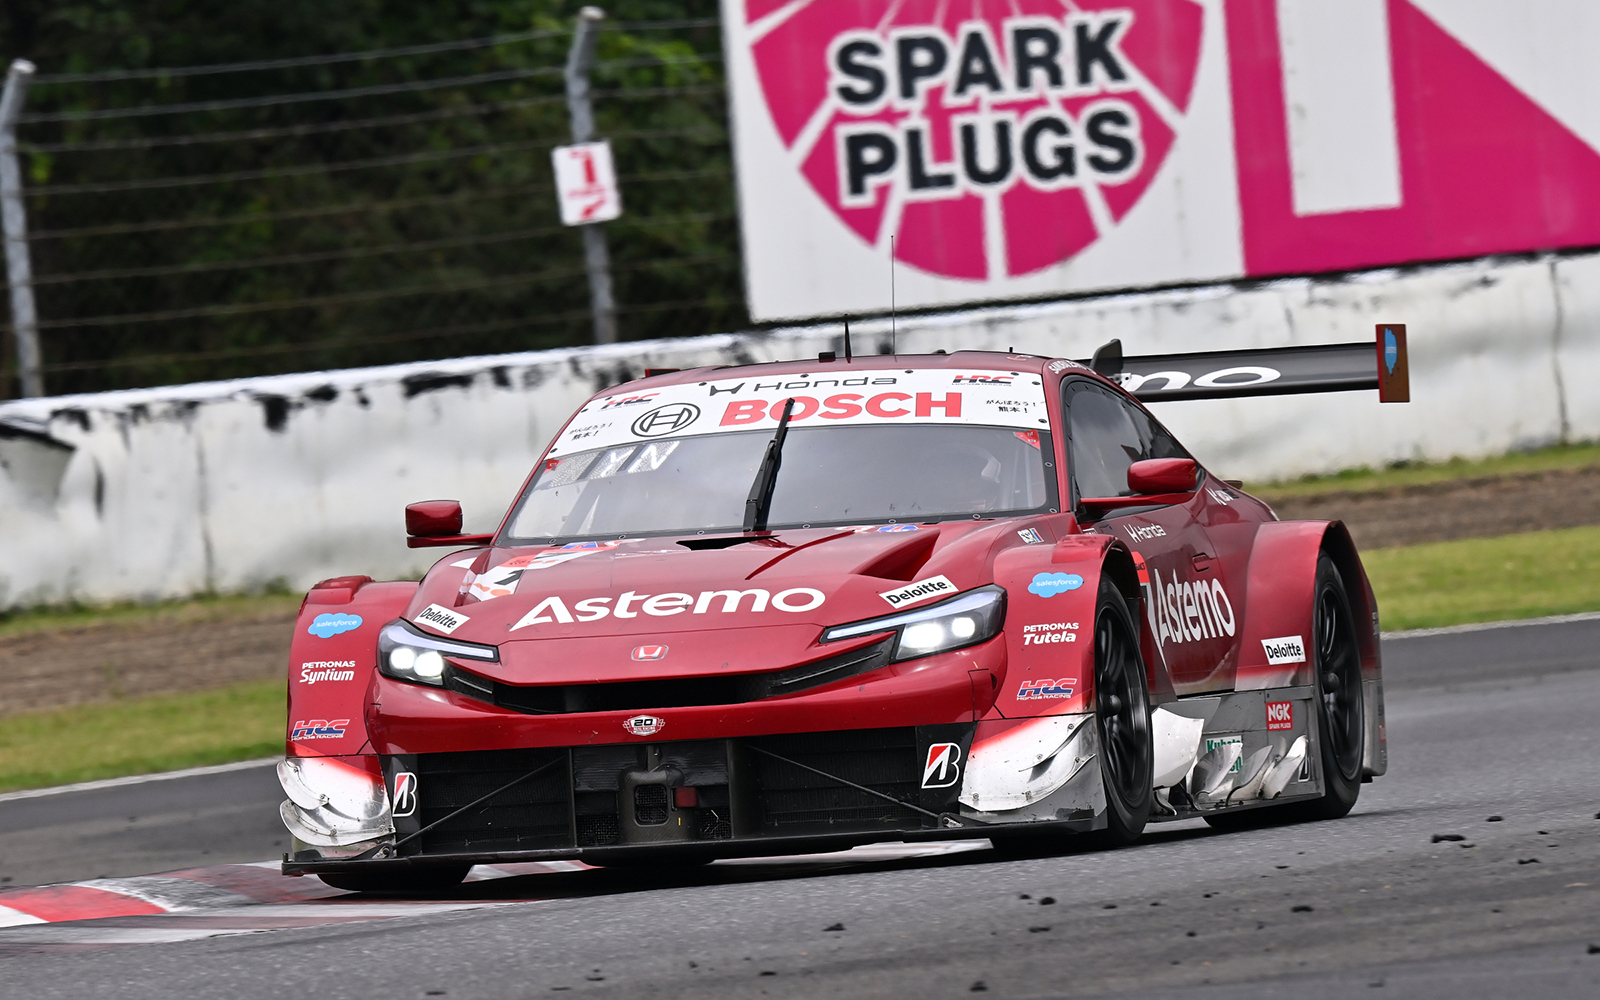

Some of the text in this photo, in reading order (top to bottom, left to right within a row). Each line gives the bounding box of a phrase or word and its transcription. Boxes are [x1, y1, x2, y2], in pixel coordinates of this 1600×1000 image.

[836, 17, 1127, 105] SPARK
[845, 109, 1135, 195] PLUGS
[753, 376, 898, 392] Honda
[953, 375, 1014, 385] HRC
[719, 392, 962, 427] BOSCH
[1036, 579, 1078, 587] salesforce
[509, 587, 826, 632] Astemo
[1154, 568, 1236, 648] Astemo
[316, 619, 358, 628] salesforce
[1023, 622, 1079, 632] PETRONAS
[1023, 631, 1076, 645] Tutela
[302, 660, 356, 669] PETRONAS
[299, 668, 354, 684] Syntium
[1017, 678, 1077, 696] HRC
[1267, 703, 1292, 722] NGK
[292, 719, 350, 737] HRC
[634, 719, 654, 727] 20
